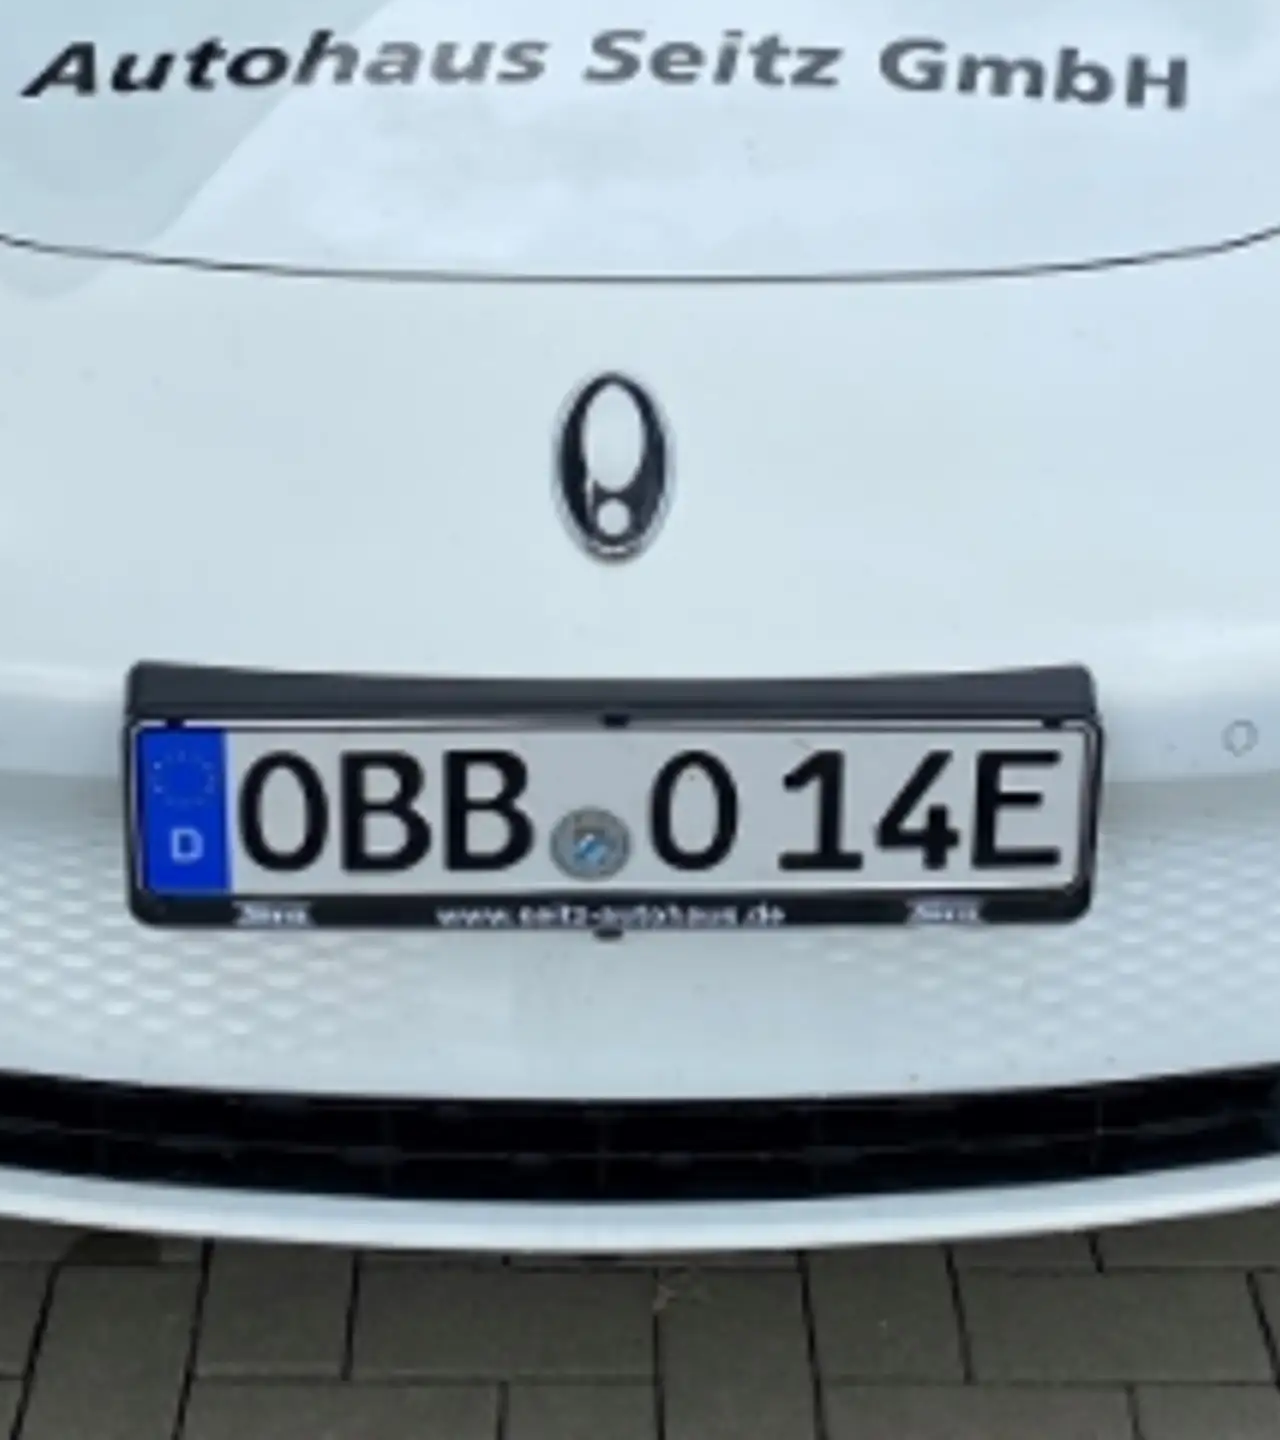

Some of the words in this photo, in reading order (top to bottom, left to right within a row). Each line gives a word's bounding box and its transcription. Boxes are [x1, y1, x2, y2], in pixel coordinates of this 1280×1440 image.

[19, 27, 549, 100] Autohaus
[583, 28, 844, 88] Seitz
[878, 37, 1189, 111] GmbH
[170, 827, 204, 862] D
[237, 749, 535, 874] OBB
[777, 749, 1062, 873] 14E
